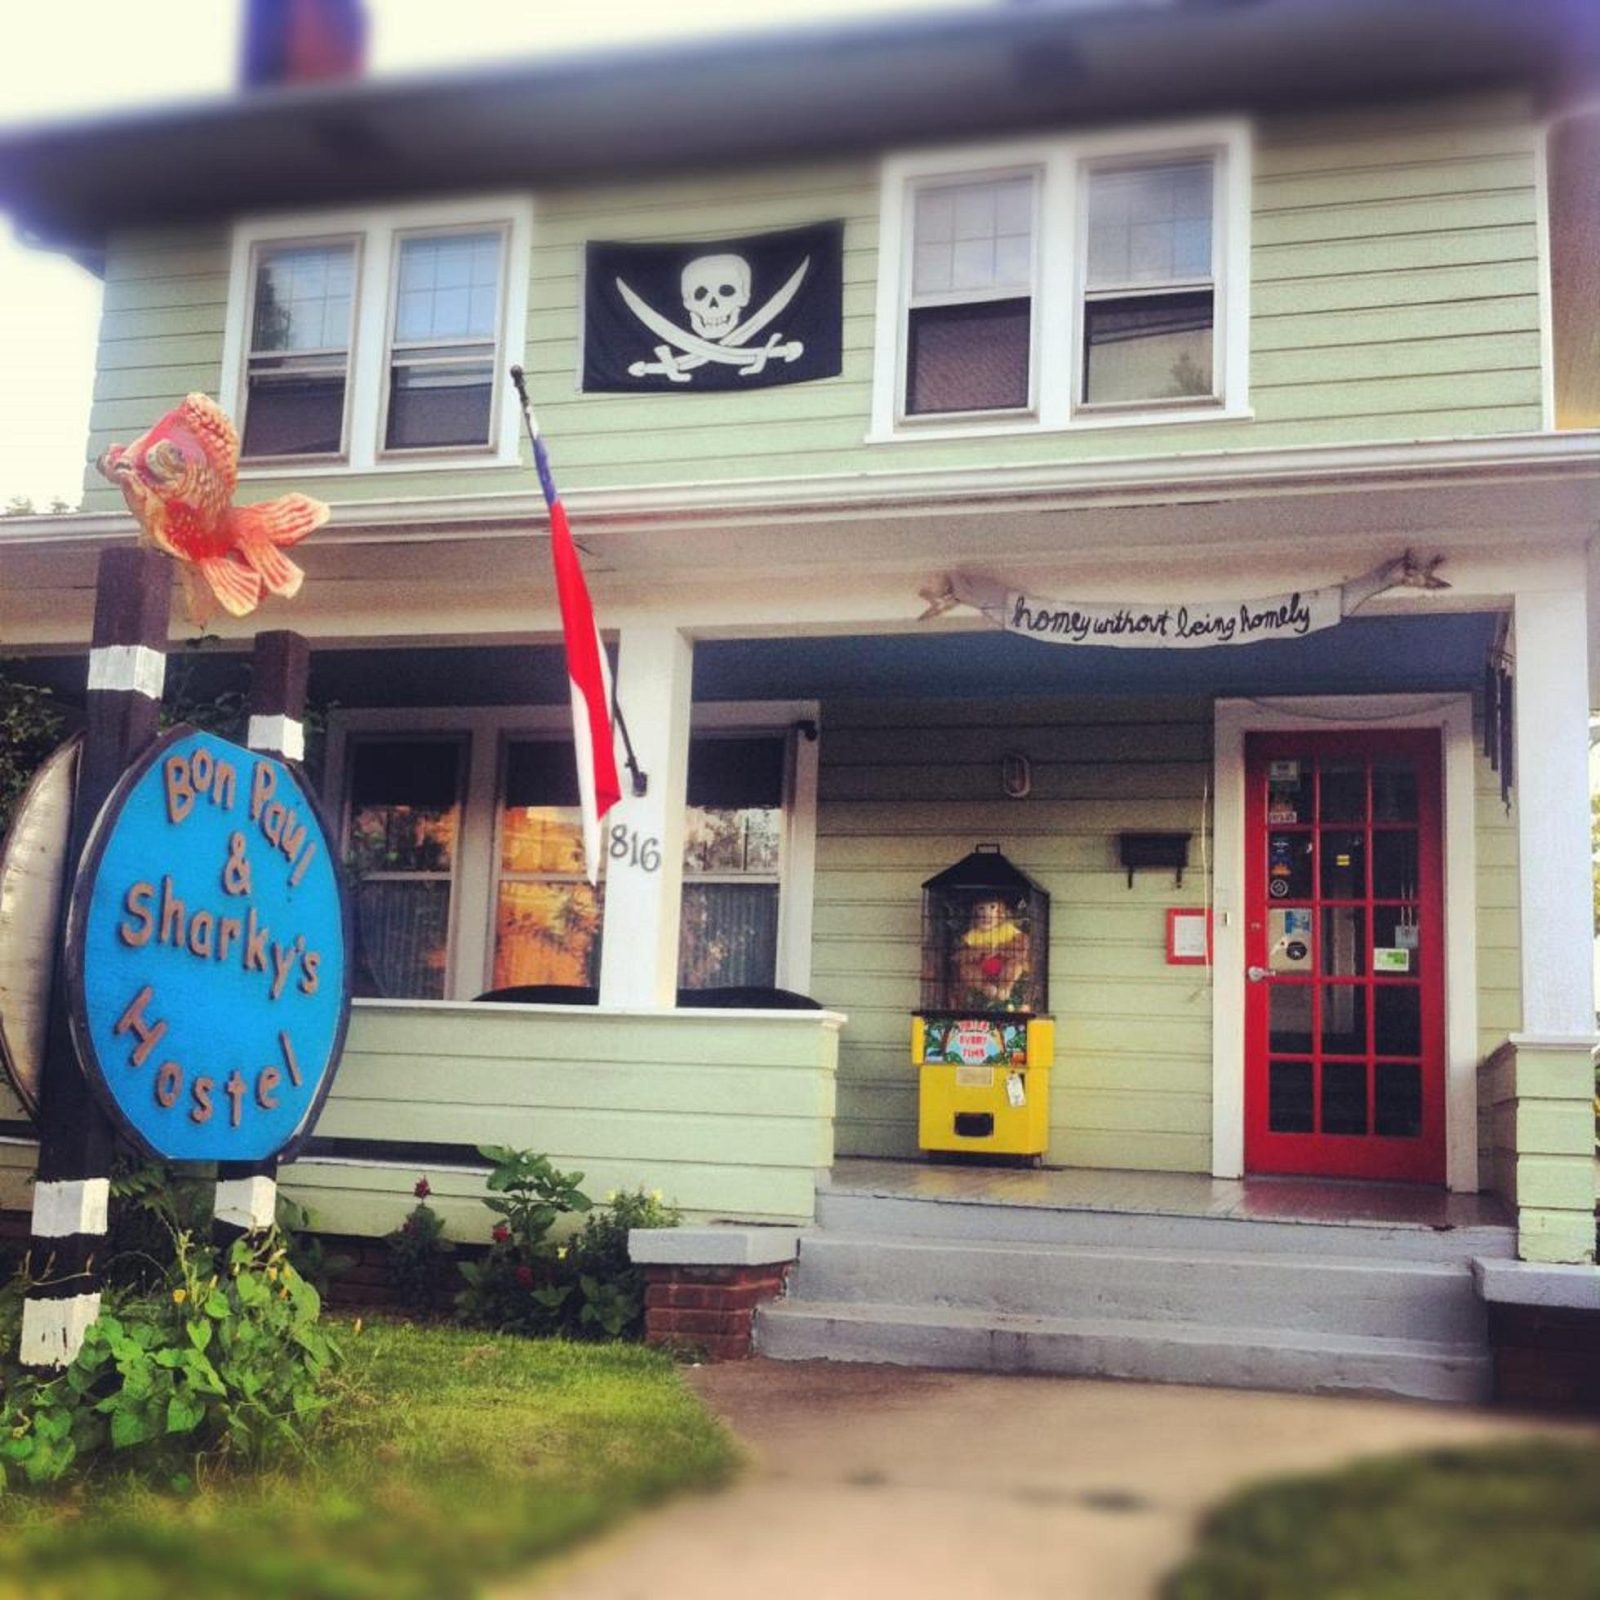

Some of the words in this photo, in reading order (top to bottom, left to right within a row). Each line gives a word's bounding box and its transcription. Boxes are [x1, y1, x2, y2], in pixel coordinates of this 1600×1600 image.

[1013, 596, 1089, 641] homey
[1093, 609, 1170, 637] without
[1175, 606, 1235, 641] being
[1240, 592, 1311, 632] homely
[164, 748, 236, 823] Bon
[250, 761, 316, 886] Paul
[223, 830, 251, 896] &
[609, 824, 661, 872] 816
[120, 874, 320, 999] Sharky's
[113, 986, 302, 1127] Hostel
